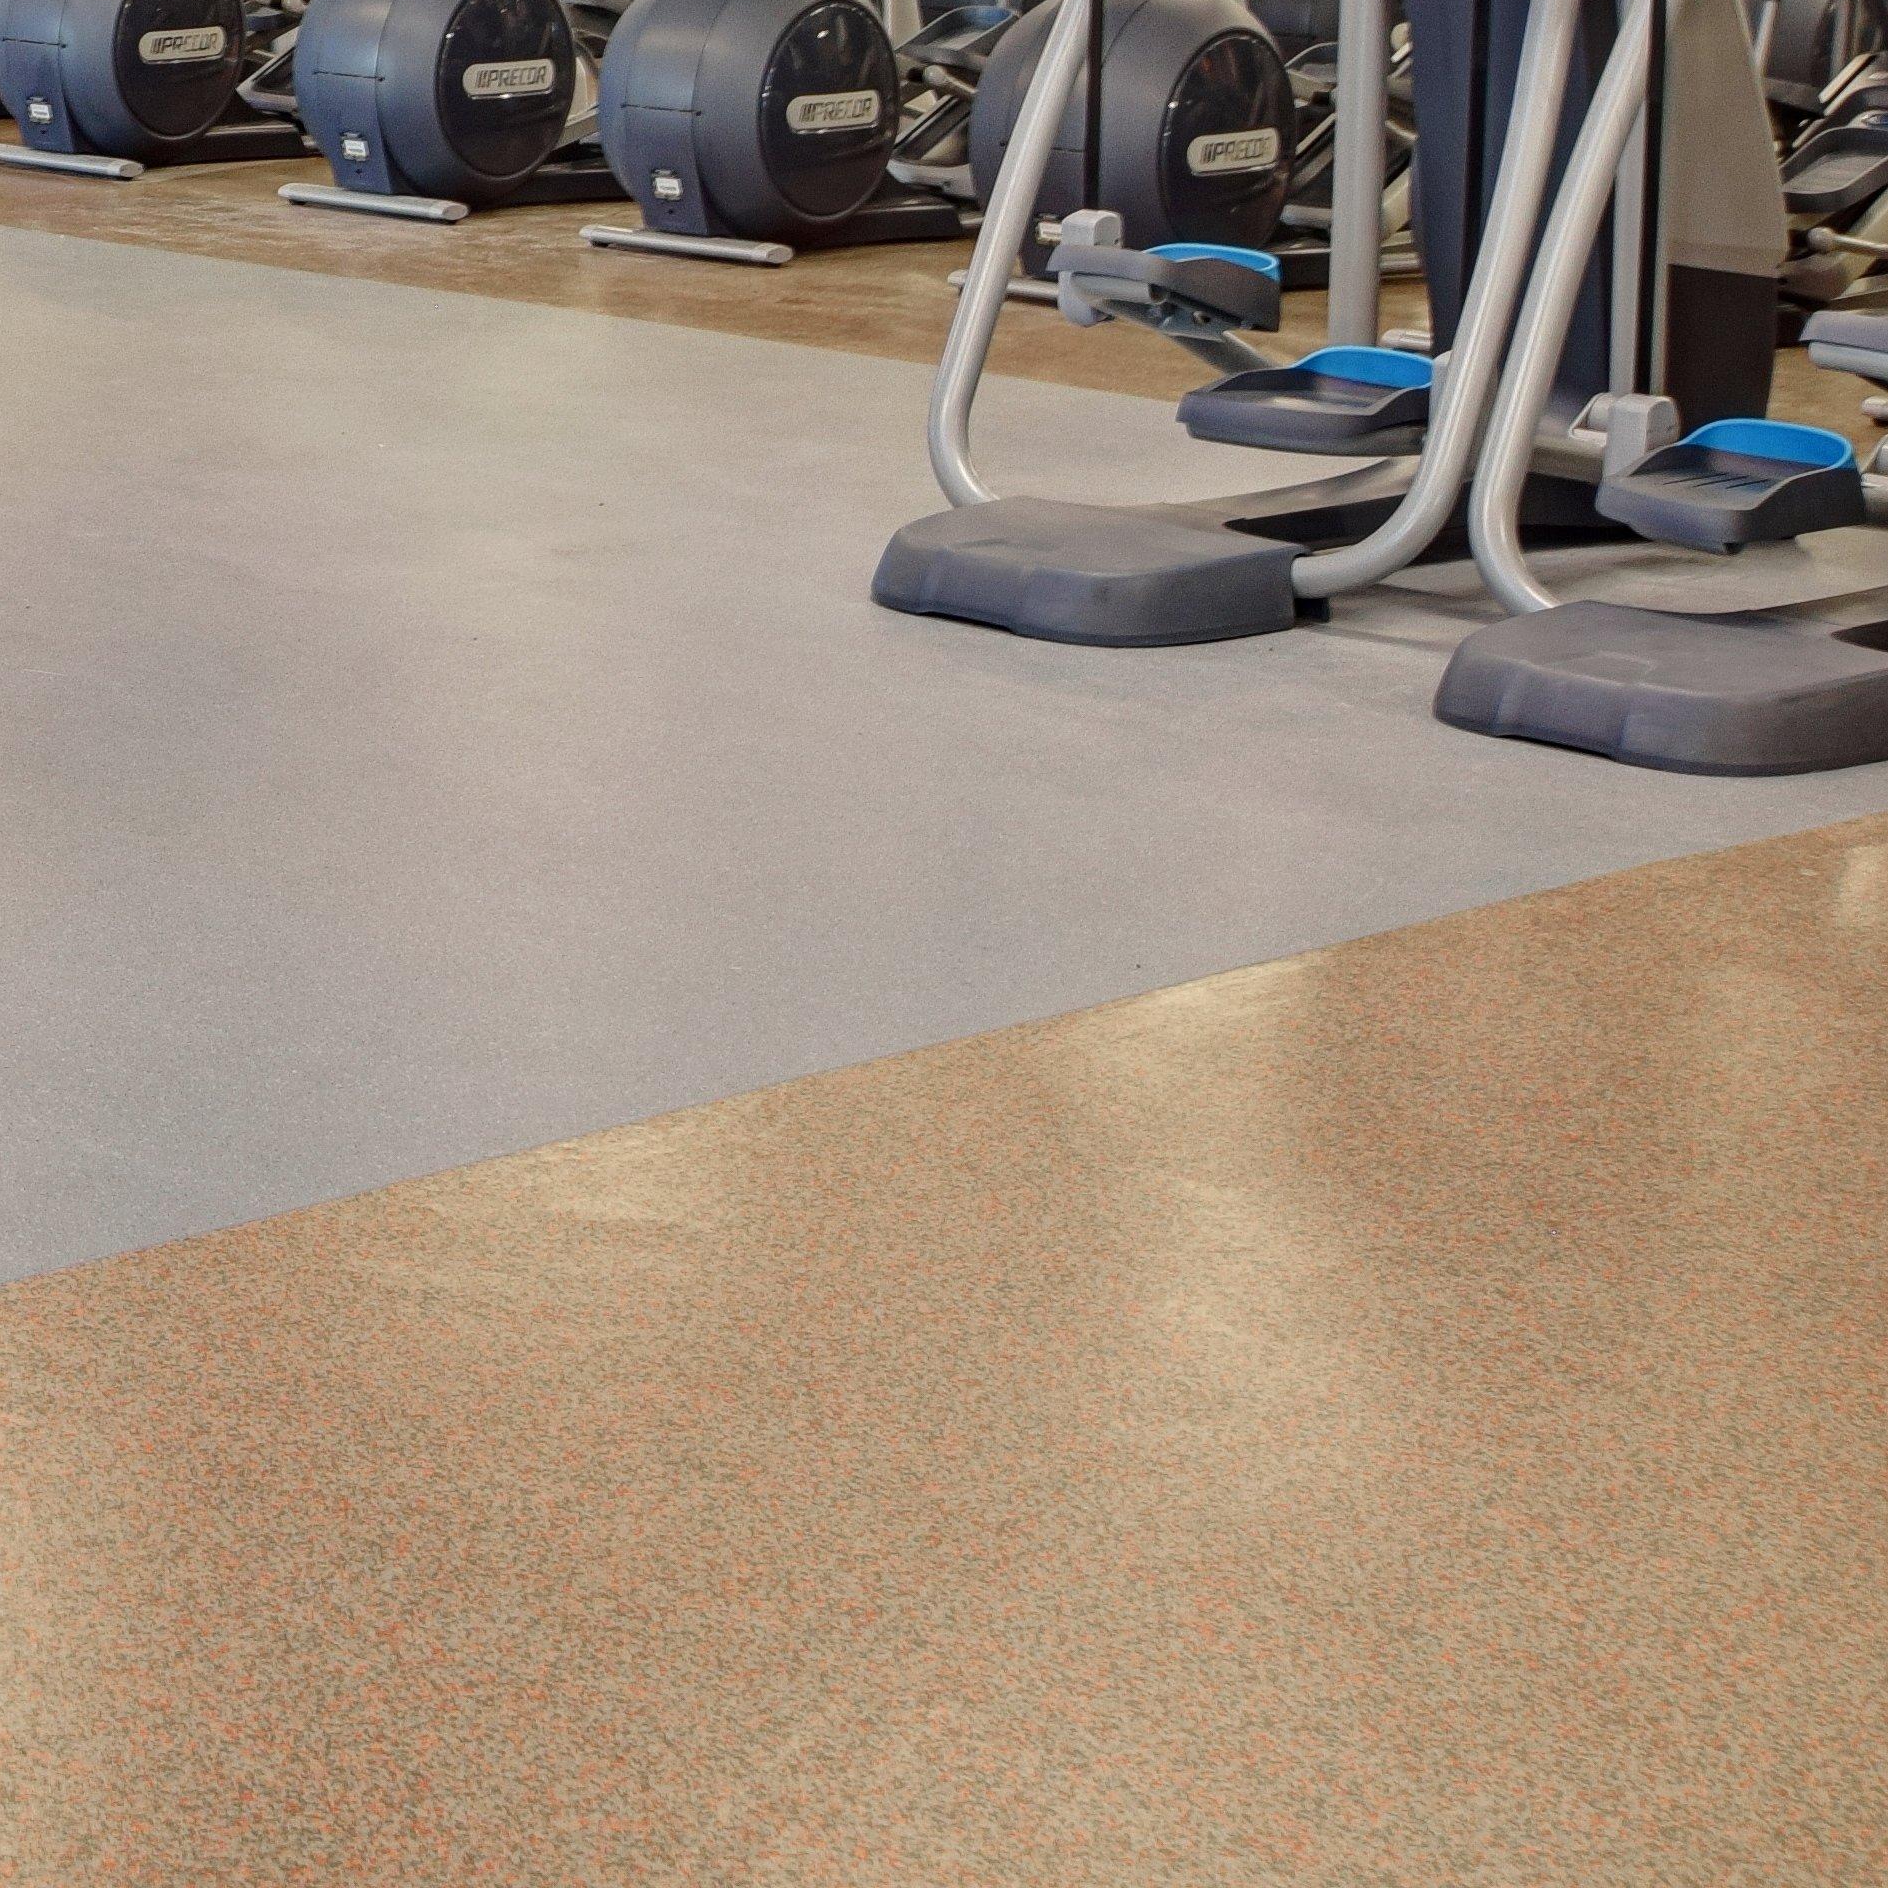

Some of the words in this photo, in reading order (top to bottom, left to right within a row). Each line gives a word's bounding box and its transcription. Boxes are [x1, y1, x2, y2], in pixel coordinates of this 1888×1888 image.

[161, 32, 218, 52] PRECOR
[488, 65, 547, 87] PRECOR
[815, 97, 873, 118] PRECOR
